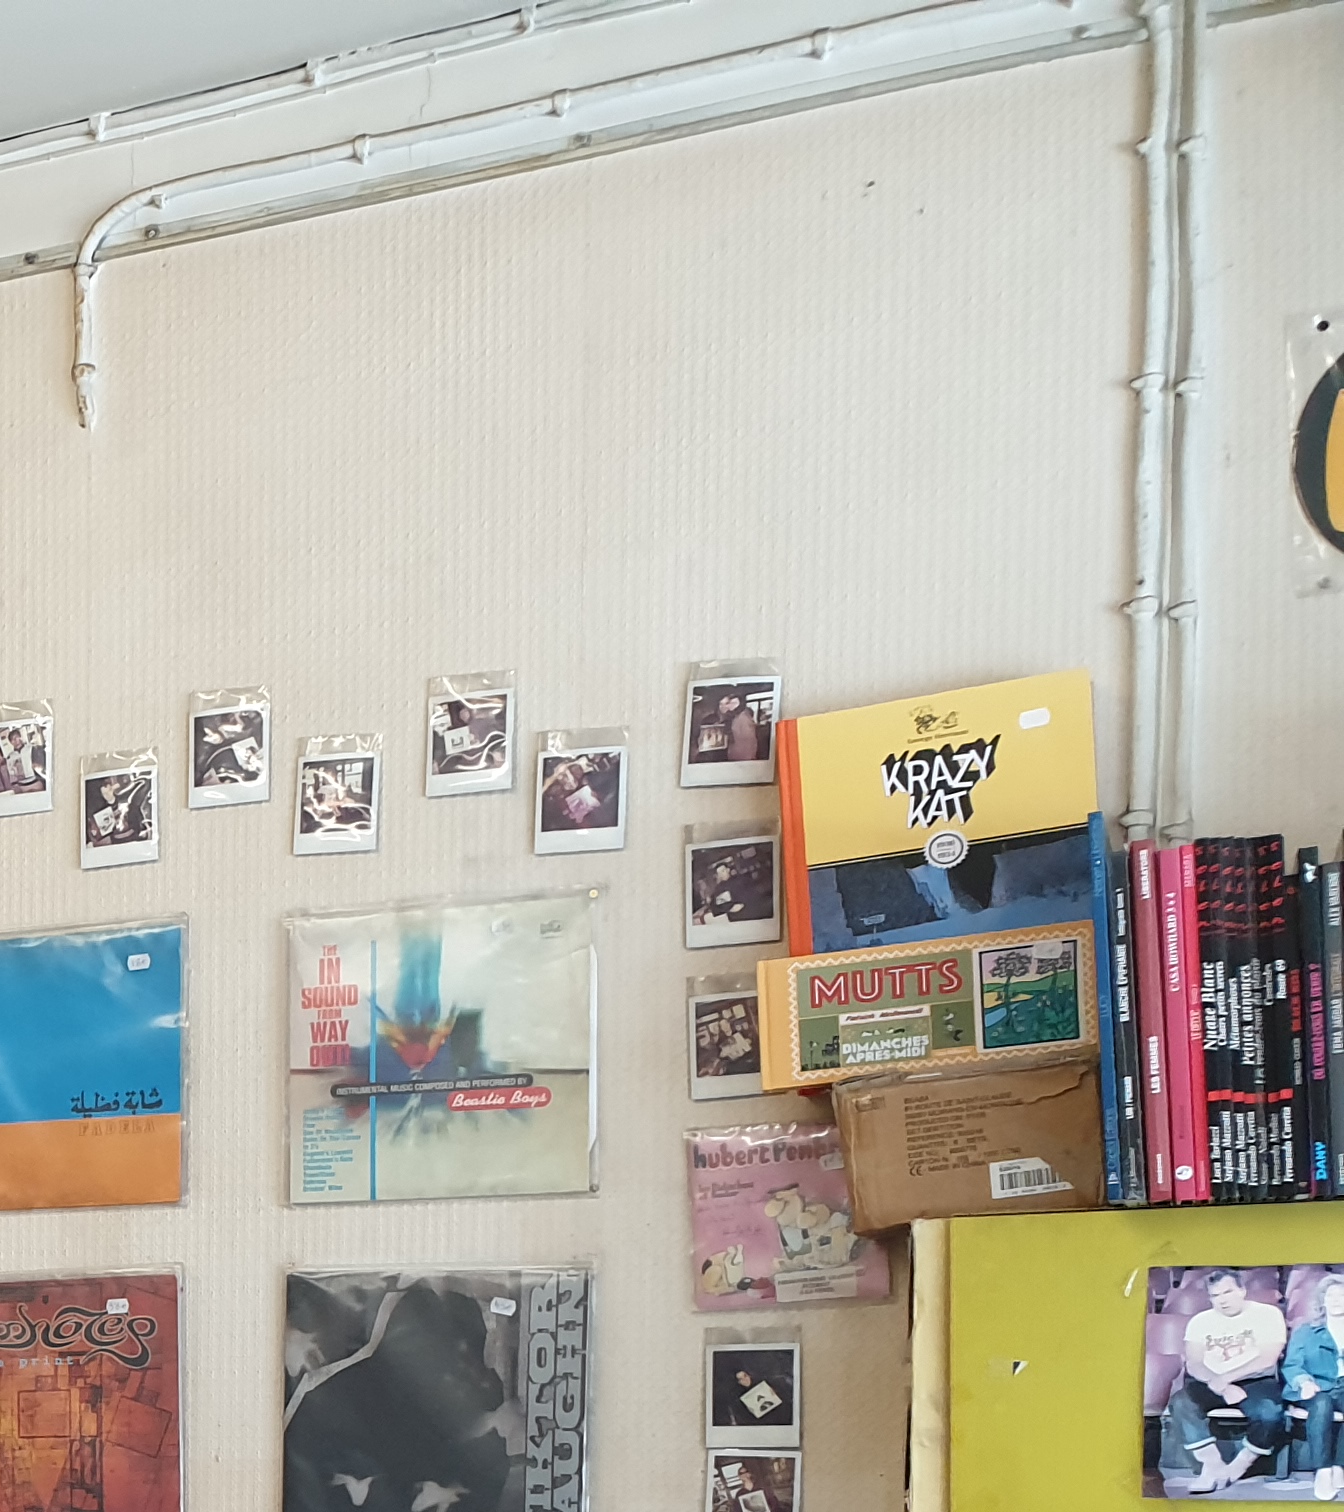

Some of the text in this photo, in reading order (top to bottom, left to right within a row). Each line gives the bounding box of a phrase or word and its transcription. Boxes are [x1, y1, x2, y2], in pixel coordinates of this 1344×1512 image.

[880, 745, 996, 797] KRAZY
[907, 788, 967, 829] KAT
[318, 957, 341, 985] IN
[809, 957, 964, 1010] MUTTS
[301, 984, 359, 1010] SOUND
[310, 1019, 349, 1044] WAY
[841, 1034, 930, 1055] DIMANCHES
[451, 1089, 549, 1108] Beastie Boys
[693, 1143, 771, 1171] hubert
[1314, 1141, 1329, 1181] DANY
[18, 1354, 75, 1373] print
